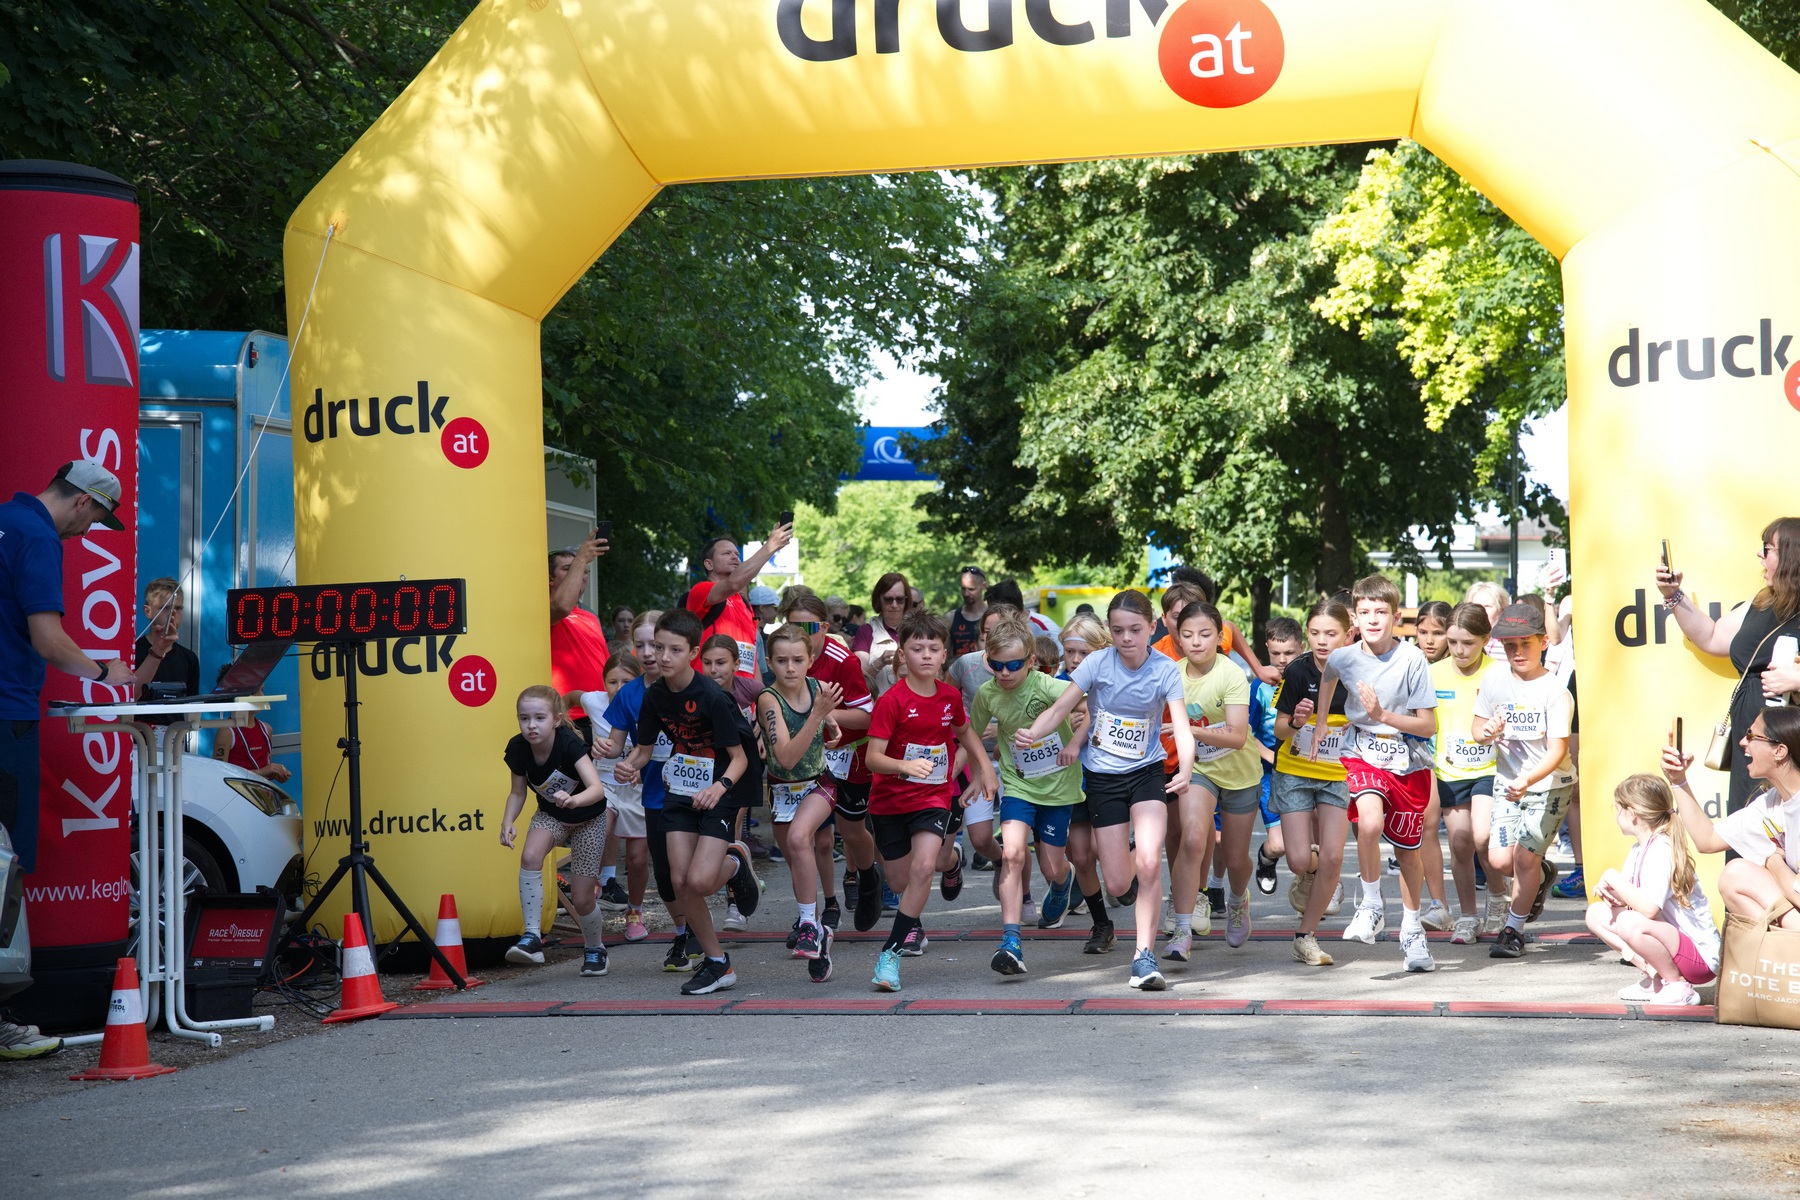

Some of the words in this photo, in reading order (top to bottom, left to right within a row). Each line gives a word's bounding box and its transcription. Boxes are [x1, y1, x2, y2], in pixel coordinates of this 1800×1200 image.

[1188, 21, 1255, 78] at
[1608, 318, 1793, 387] druck
[304, 381, 450, 443] druck
[453, 431, 478, 454] at
[237, 585, 455, 638] 00:00:00
[461, 669, 486, 687] at
[1506, 712, 1540, 724] 26087
[1108, 726, 1145, 742] 26021
[1022, 744, 1060, 762] 26835
[1112, 740, 1137, 750] ANNIKA
[1367, 738, 1406, 754] 26055
[1456, 744, 1492, 756] 26057
[825, 750, 848, 763] 6841
[673, 765, 709, 781] 26026
[682, 780, 699, 788] ELIAS
[209, 929, 228, 937] RACE
[236, 929, 264, 937] RESULT
[1759, 958, 1800, 977] THE
[1729, 970, 1780, 992] TOTE
[1747, 991, 1772, 1001] MARC
[1774, 996, 1800, 1004] JACO
